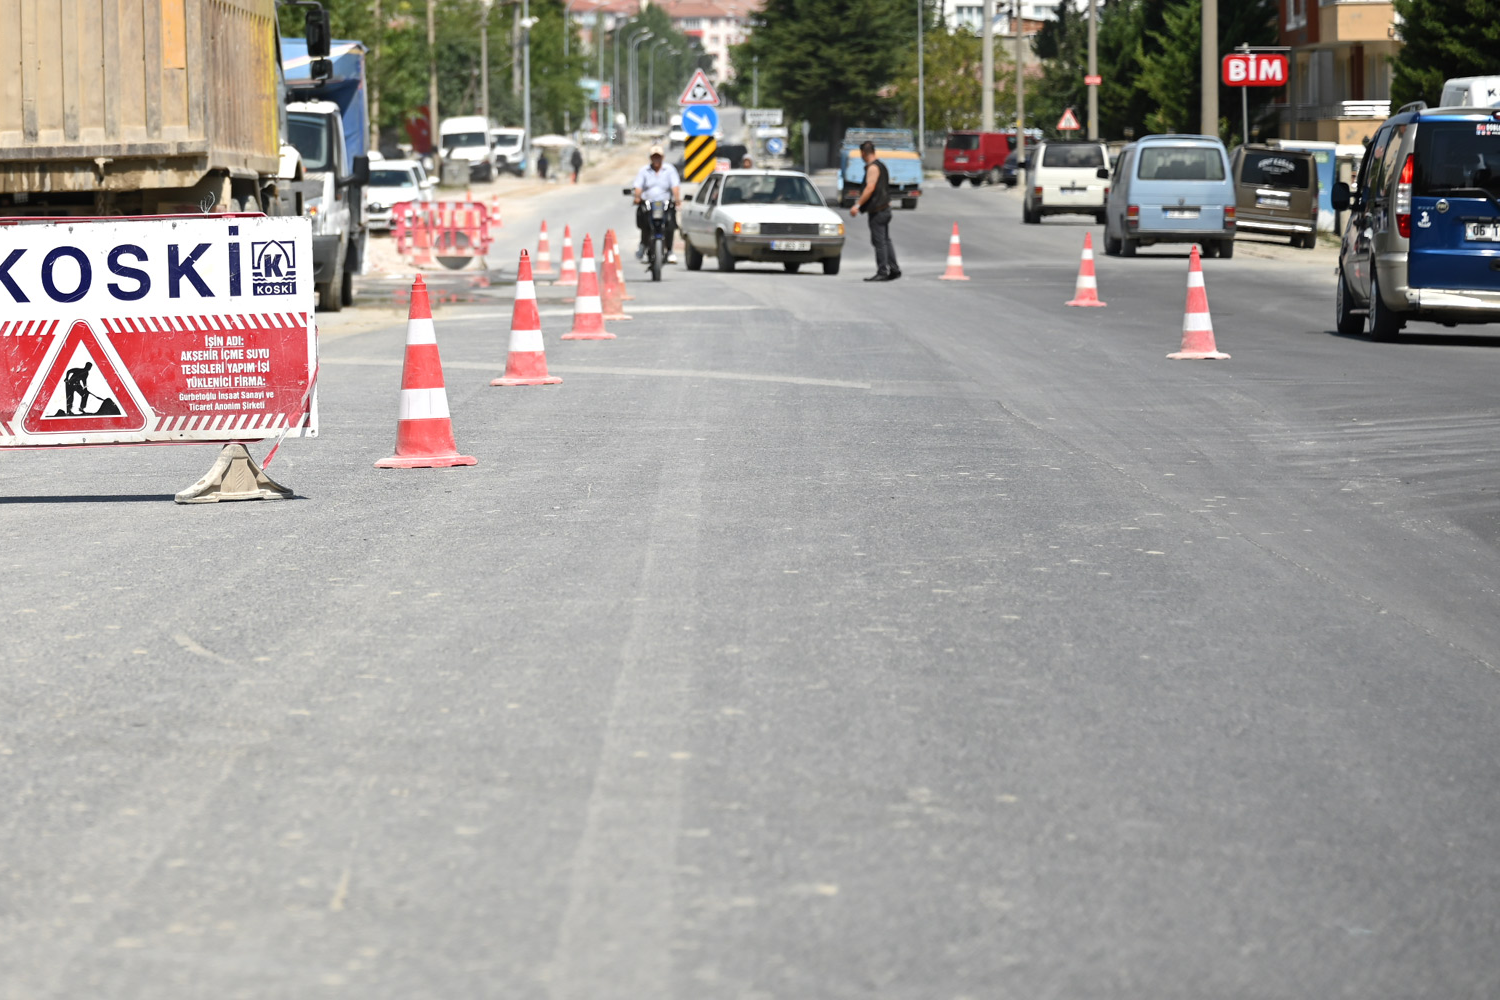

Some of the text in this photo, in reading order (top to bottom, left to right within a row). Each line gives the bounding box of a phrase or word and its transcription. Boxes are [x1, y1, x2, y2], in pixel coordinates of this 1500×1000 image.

[1228, 54, 1283, 81] BİM
[1473, 225, 1486, 236] 06
[256, 282, 293, 295] KOSKİ
[205, 335, 244, 347] İŞİN ADI:
[180, 347, 270, 361] AKŞEHİR İÇME SUYU
[181, 360, 270, 374] TESİSLERİ YAPIM İŞİ
[186, 374, 266, 388] YÜKLENİCİ FİRMA:
[241, 391, 264, 399] Sanayi
[189, 401, 265, 411] Ticaret Anonim Şirketi
